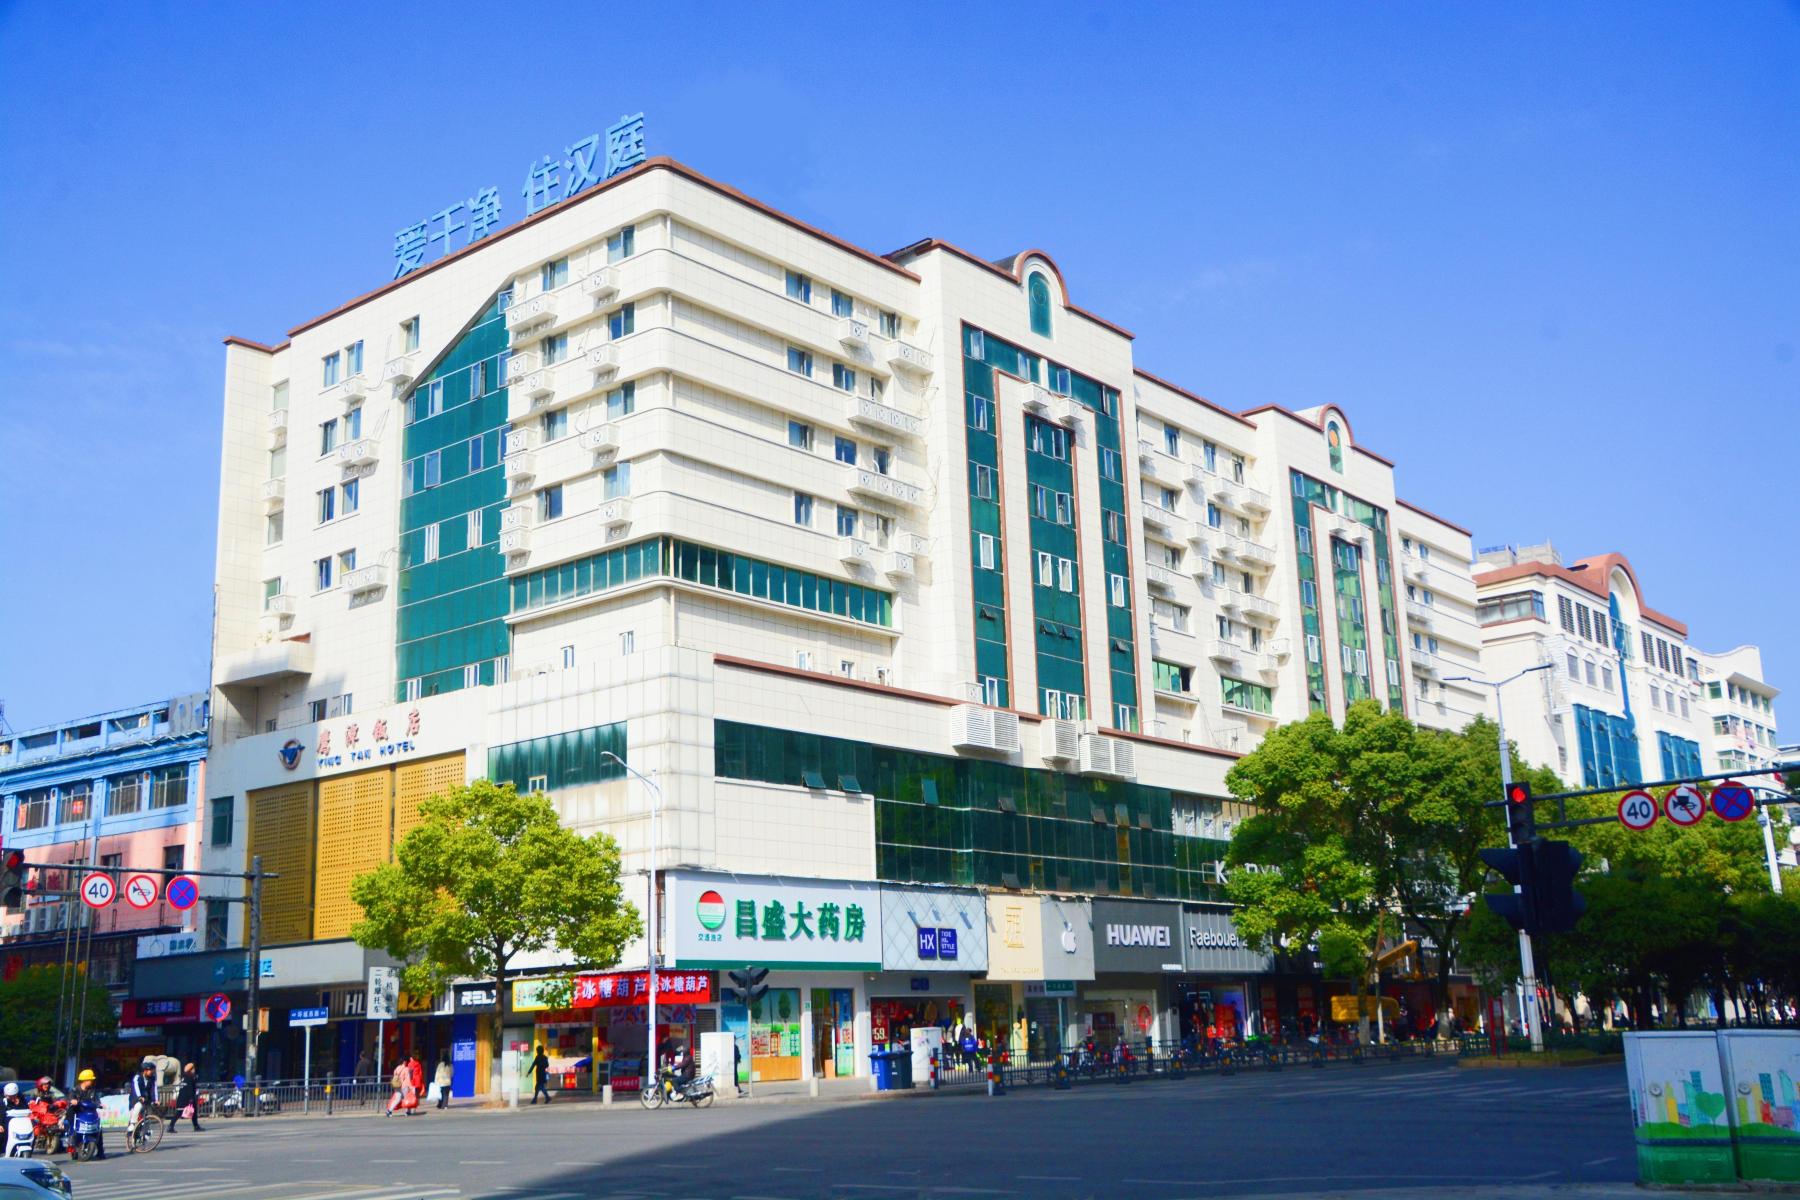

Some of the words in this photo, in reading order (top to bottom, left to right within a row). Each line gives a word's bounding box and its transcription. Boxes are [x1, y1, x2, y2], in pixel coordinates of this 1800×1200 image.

[393, 186, 501, 280] 爱干净
[521, 111, 648, 217] 住汉庭
[317, 754, 342, 769] YING
[351, 749, 372, 764] TAN
[380, 740, 416, 757] HOTEL
[1627, 801, 1651, 820] 40
[88, 882, 109, 899] 40
[735, 899, 866, 942] 昌盛大药房
[920, 934, 935, 950] HX
[1106, 923, 1171, 947] HUAWEI
[345, 992, 366, 1015] HL
